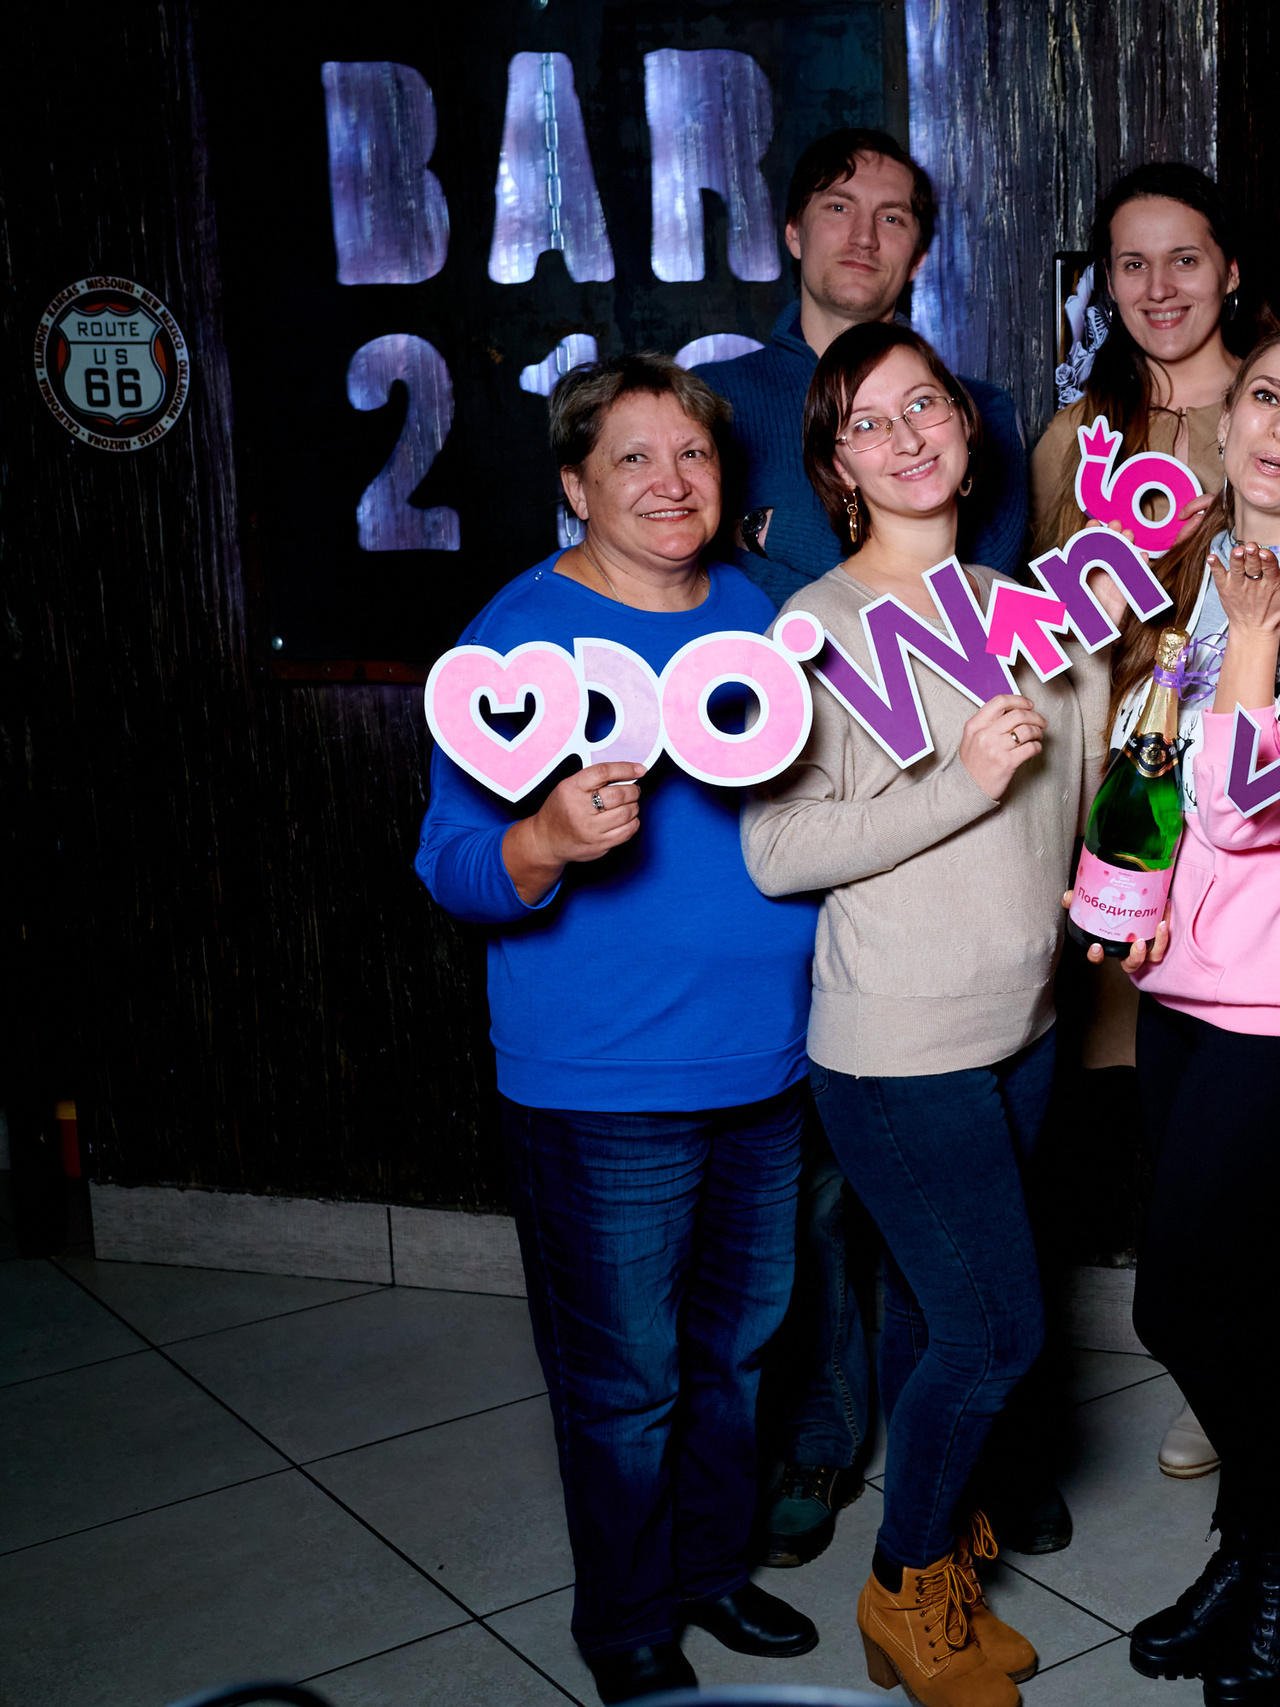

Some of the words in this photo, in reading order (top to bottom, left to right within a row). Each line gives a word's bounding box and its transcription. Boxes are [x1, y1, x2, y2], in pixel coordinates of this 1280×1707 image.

[321, 48, 782, 285] BAR
[86, 277, 135, 293] MISSOURI
[141, 290, 161, 311] NEW
[48, 286, 80, 318] KANSAS
[77, 322, 140, 337] ROUTE
[159, 310, 184, 350] MEXICO
[35, 324, 49, 369] ILLINOIS
[84, 368, 142, 408] 66
[167, 360, 188, 420] OKLAHOMA
[38, 377, 81, 434] CALIFORNIA
[87, 432, 132, 450] ARIZONA
[138, 423, 167, 446] TEXAS
[1078, 886, 1158, 918] Победители
